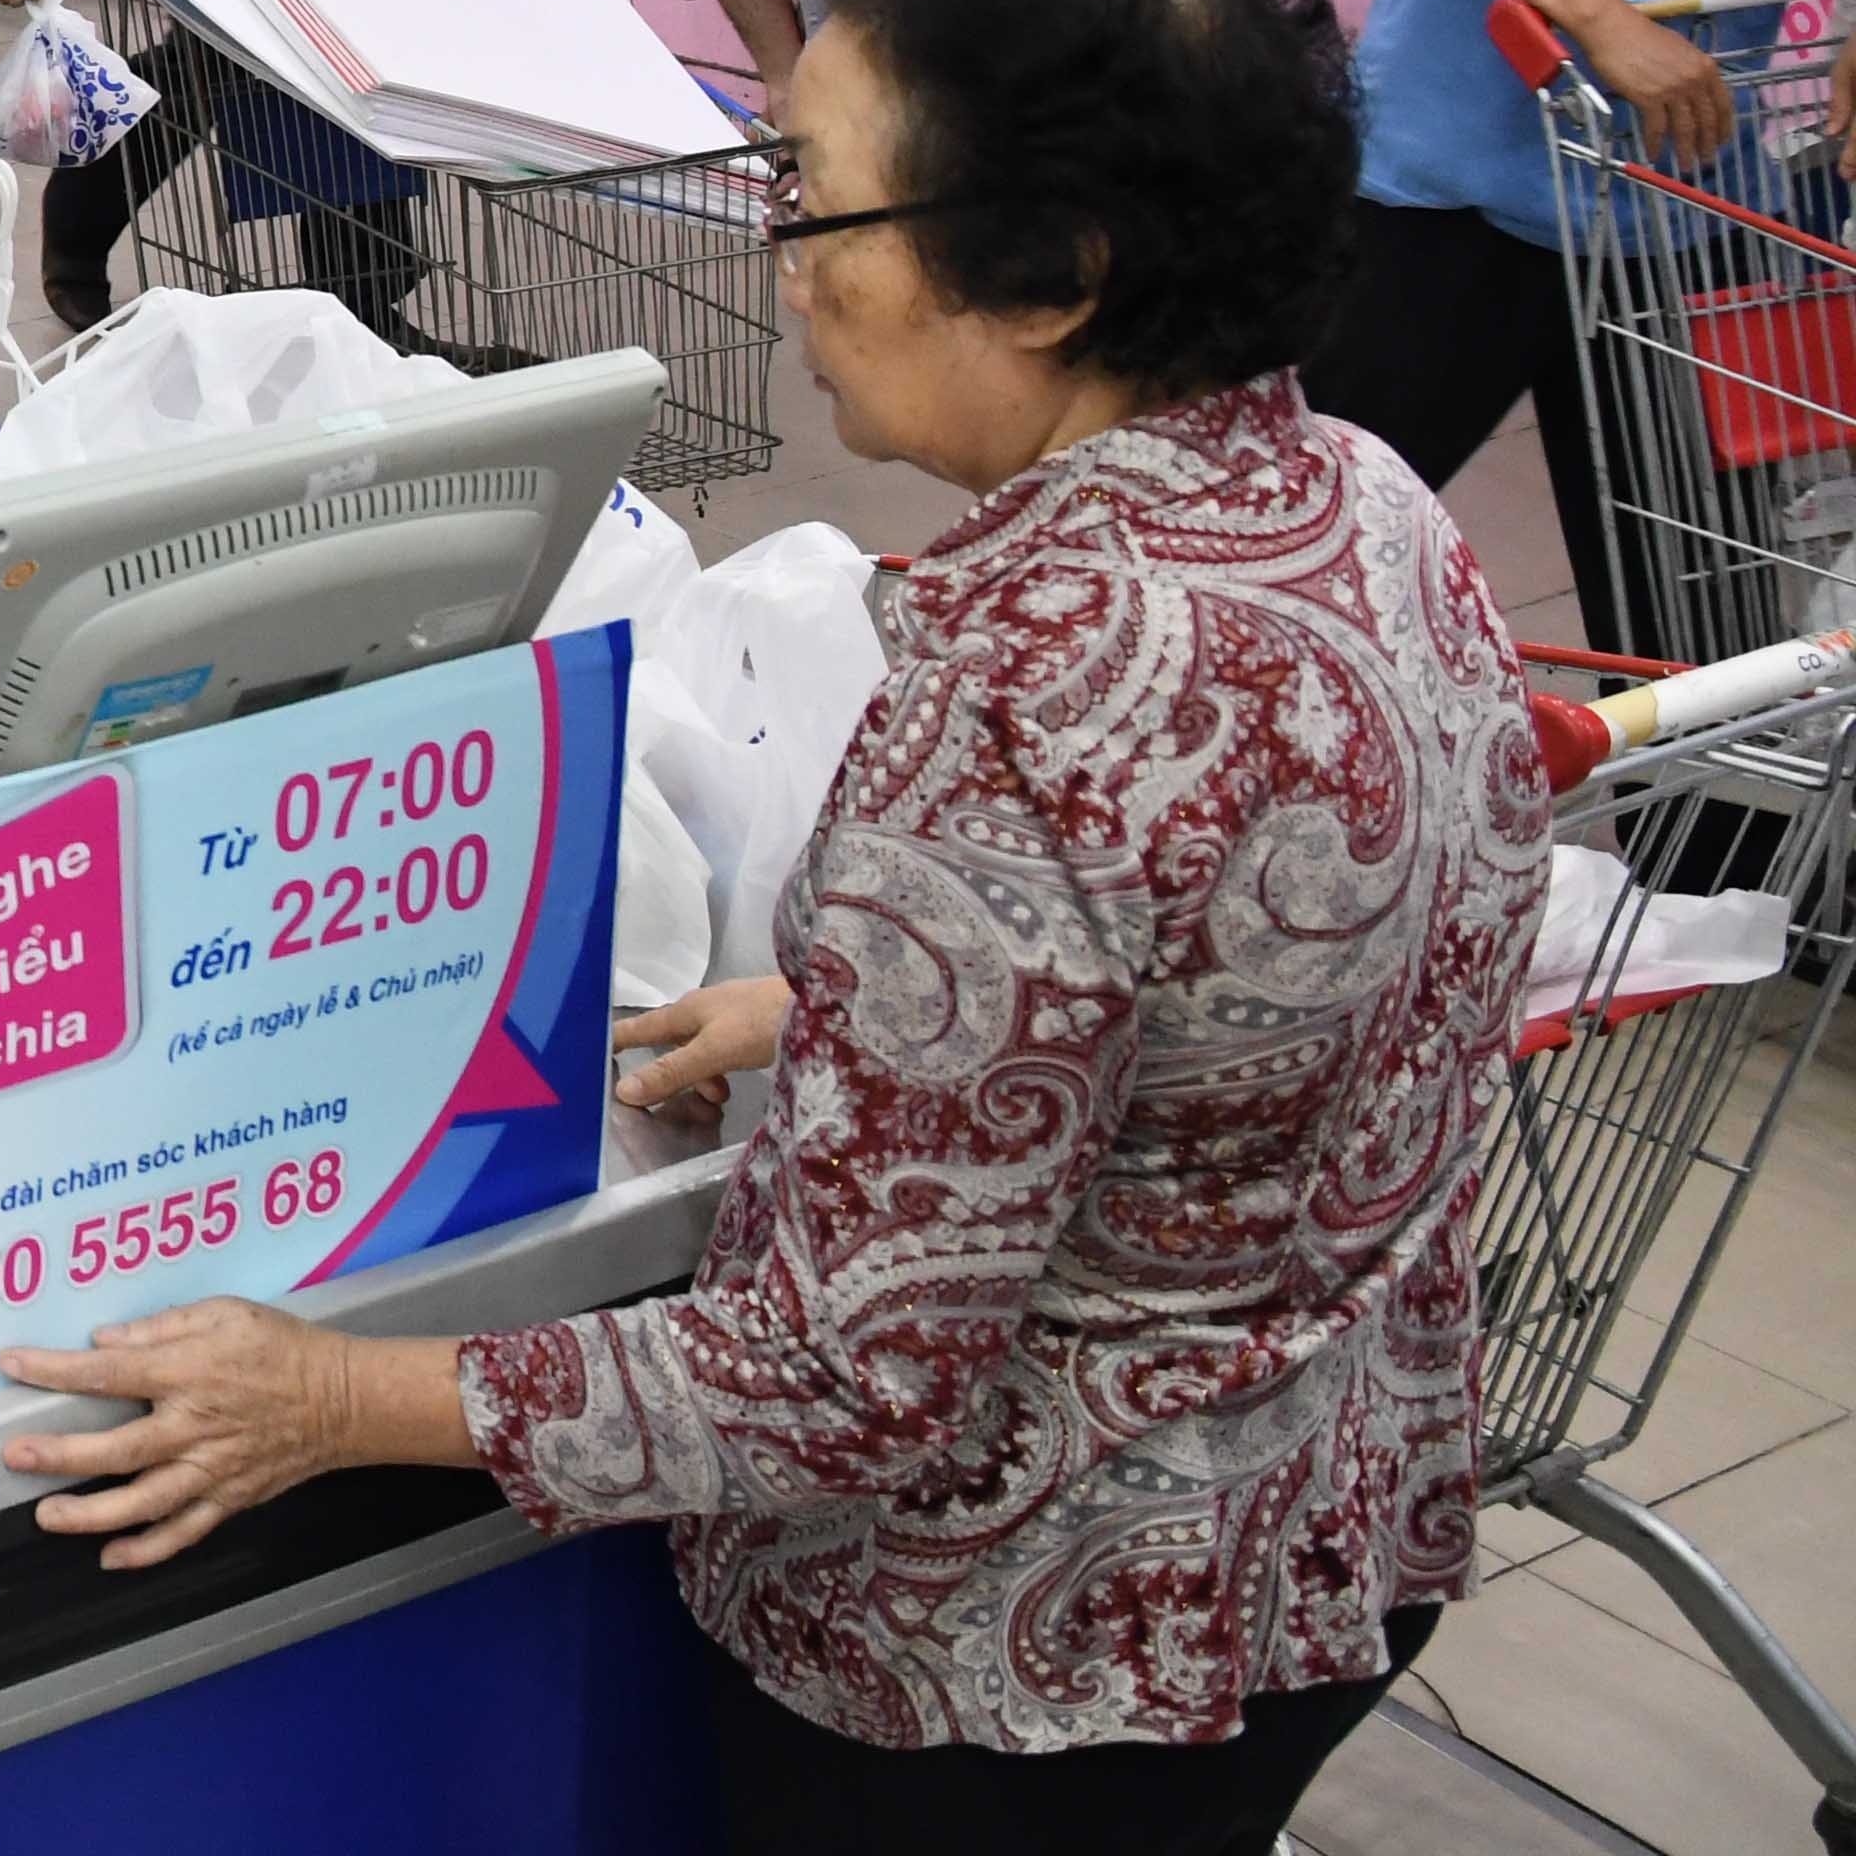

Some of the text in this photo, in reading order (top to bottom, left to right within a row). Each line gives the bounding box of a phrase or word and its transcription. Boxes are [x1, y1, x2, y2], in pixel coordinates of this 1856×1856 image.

[275, 727, 497, 856] 07:00
[197, 828, 258, 879] Từ
[268, 832, 492, 962] 22:00
[165, 948, 485, 1068] (kể cả ngày lễ & Chủ nhật)
[167, 932, 253, 990] đến
[0, 1172, 46, 1212] đài
[50, 1151, 131, 1201] chăm
[135, 1138, 187, 1179] sóc
[192, 1112, 275, 1162] khách
[280, 1089, 350, 1142] hàng
[68, 1177, 240, 1287] 5555
[261, 1147, 346, 1236] 68
